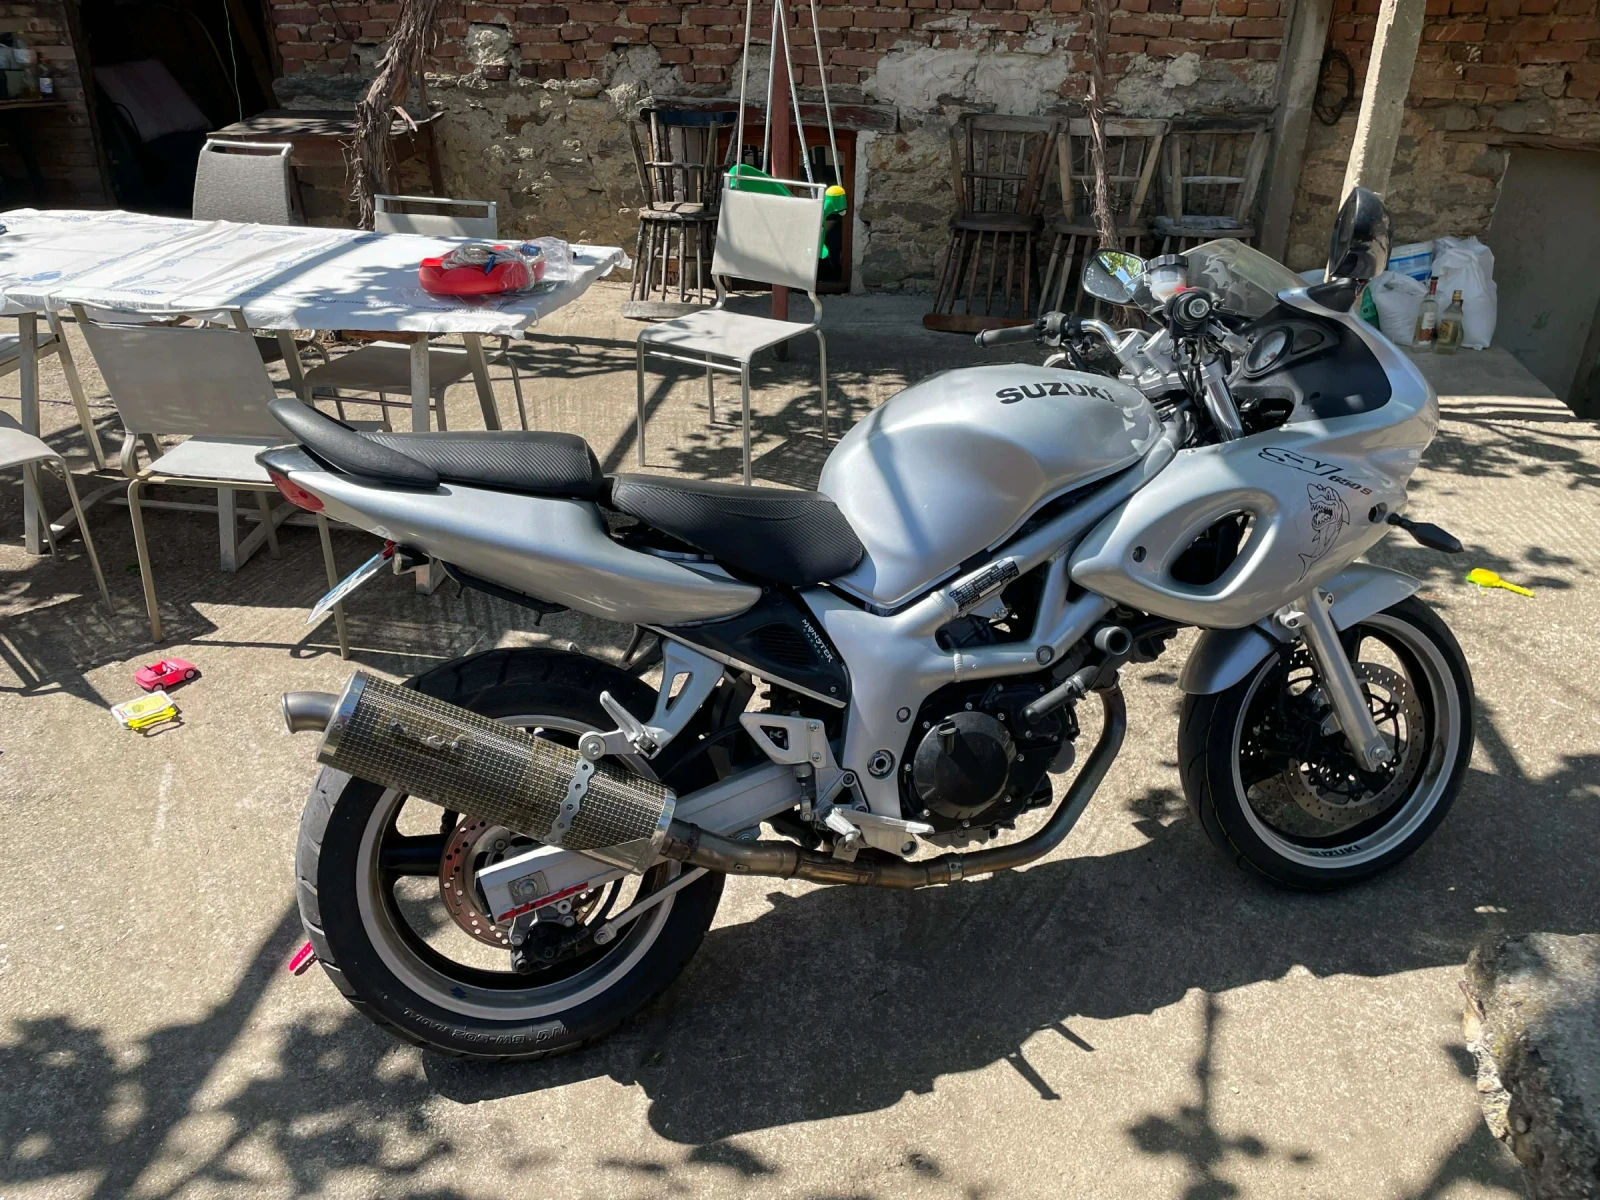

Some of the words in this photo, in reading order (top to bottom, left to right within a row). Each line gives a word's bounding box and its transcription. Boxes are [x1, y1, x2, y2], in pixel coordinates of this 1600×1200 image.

[995, 382, 1115, 404] SUZUKI
[802, 619, 833, 663] MONSTER
[1309, 844, 1361, 857] SUZUKI
